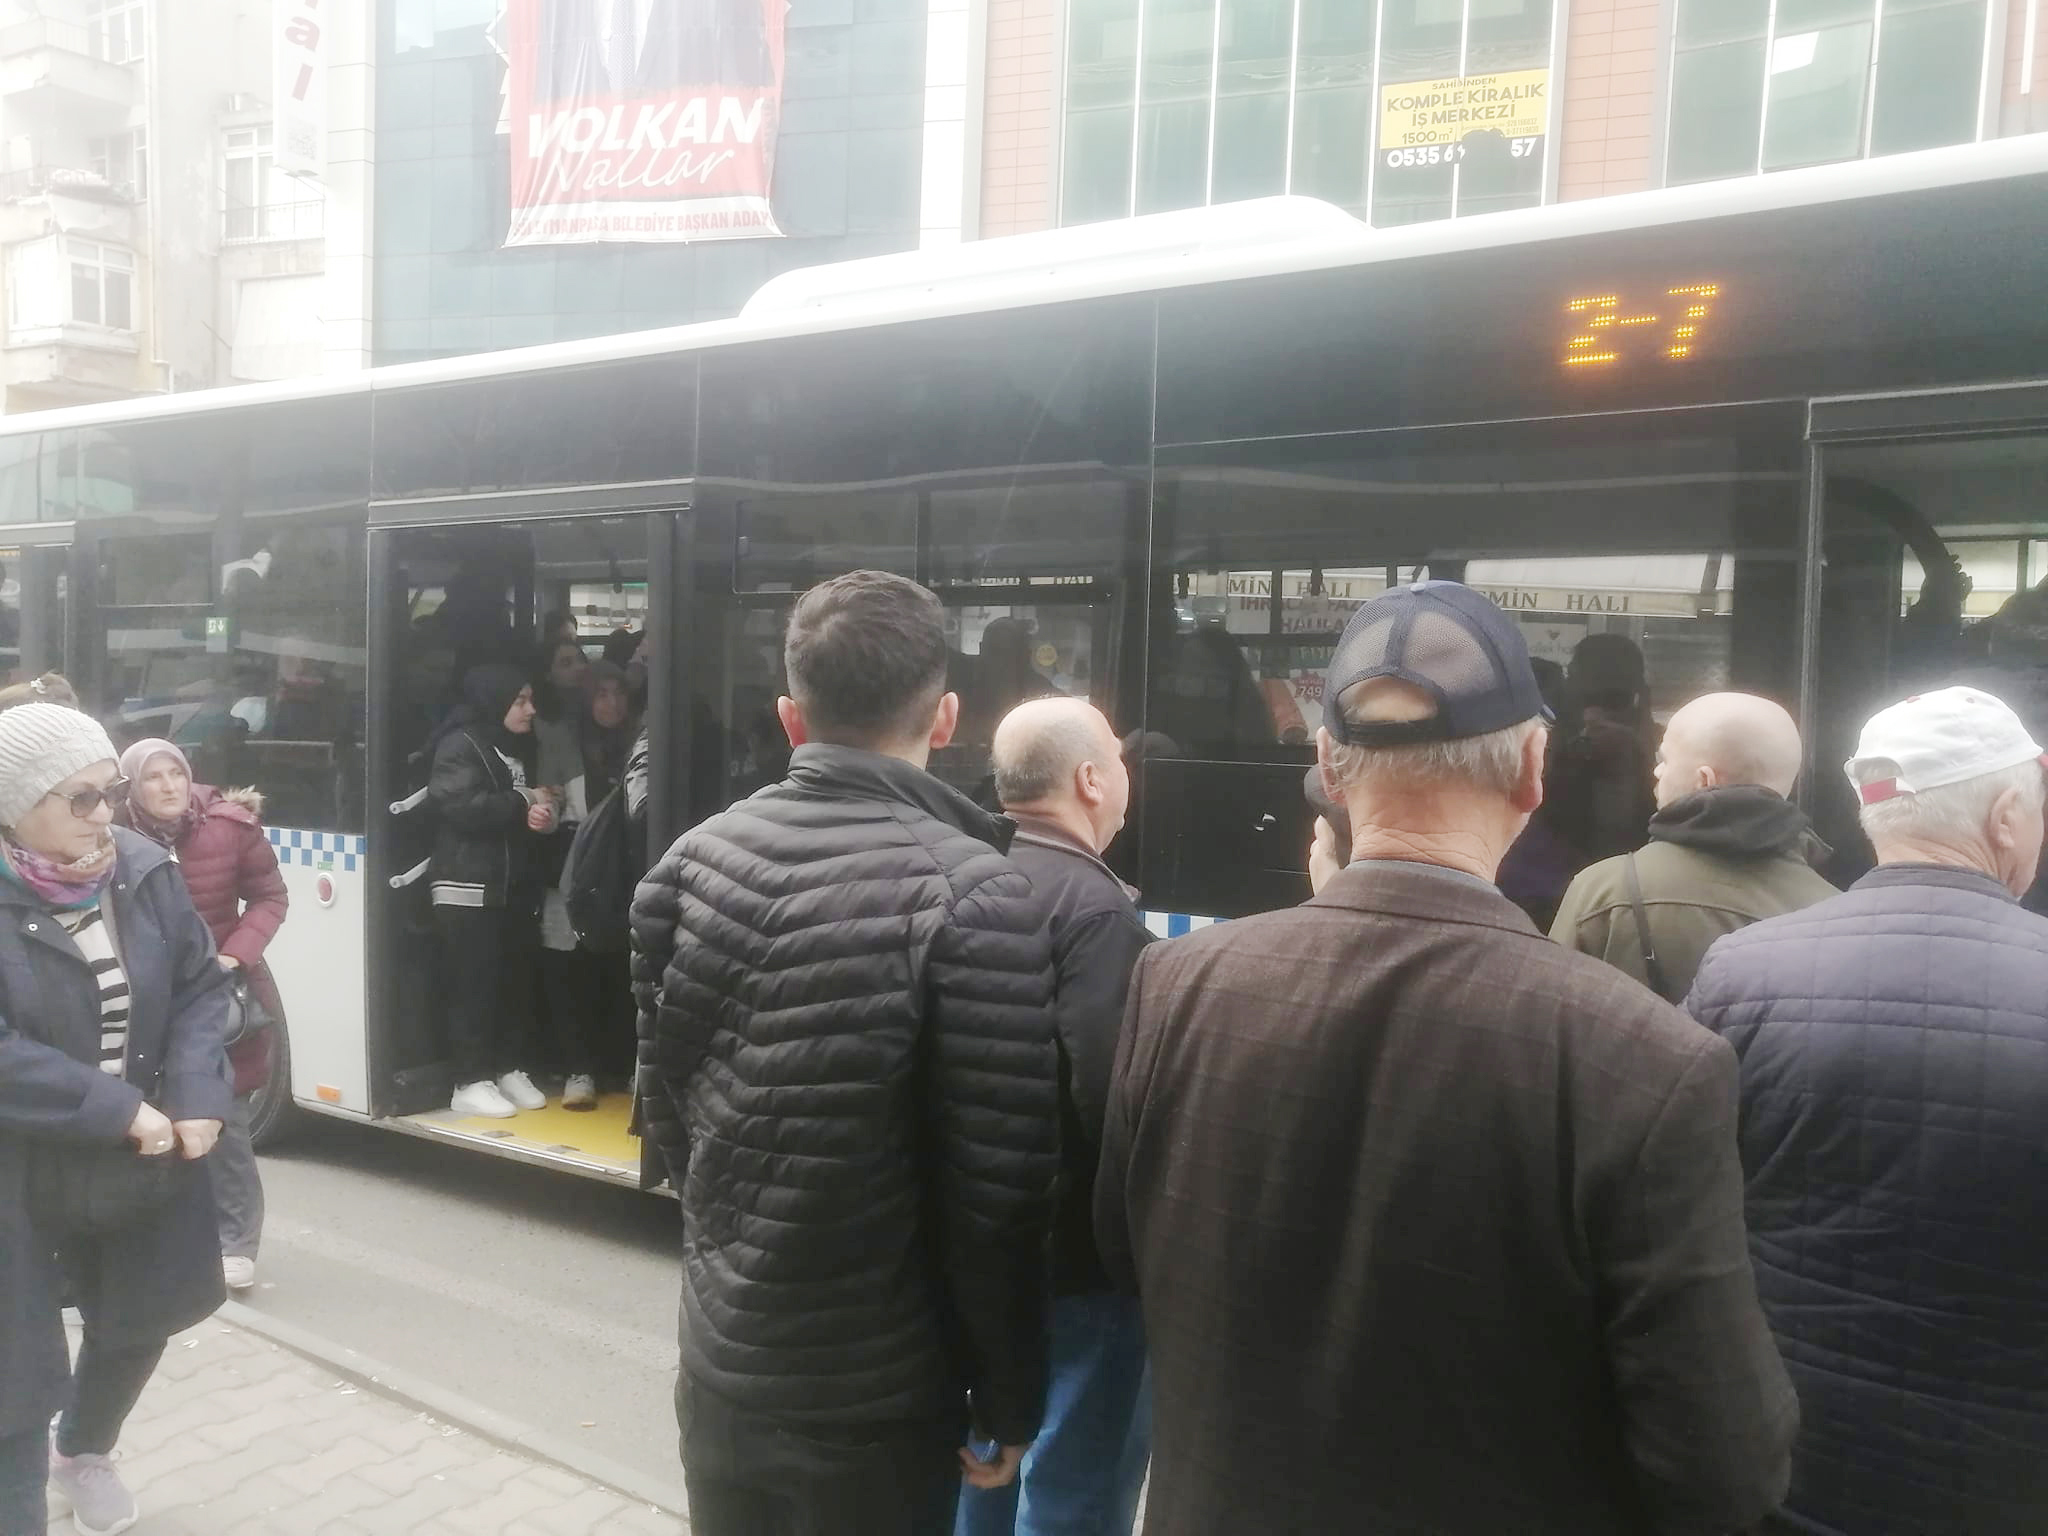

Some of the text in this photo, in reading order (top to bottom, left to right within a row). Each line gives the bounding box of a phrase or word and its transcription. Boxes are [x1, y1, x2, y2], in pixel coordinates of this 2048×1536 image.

[1387, 83, 1545, 112] KOMPLE KİRALIK
[528, 97, 765, 158] VOLKAN
[1412, 109, 1428, 129] İŞ
[1431, 100, 1516, 124] MERKEZİ
[1401, 131, 1437, 144] 1500
[1387, 146, 1440, 168] 0535
[1510, 138, 1537, 157] 57
[538, 146, 735, 198] Nallar
[677, 211, 729, 234] BAŞKAN
[1568, 284, 1718, 363] 2-7
[1565, 594, 1630, 612] HALI
